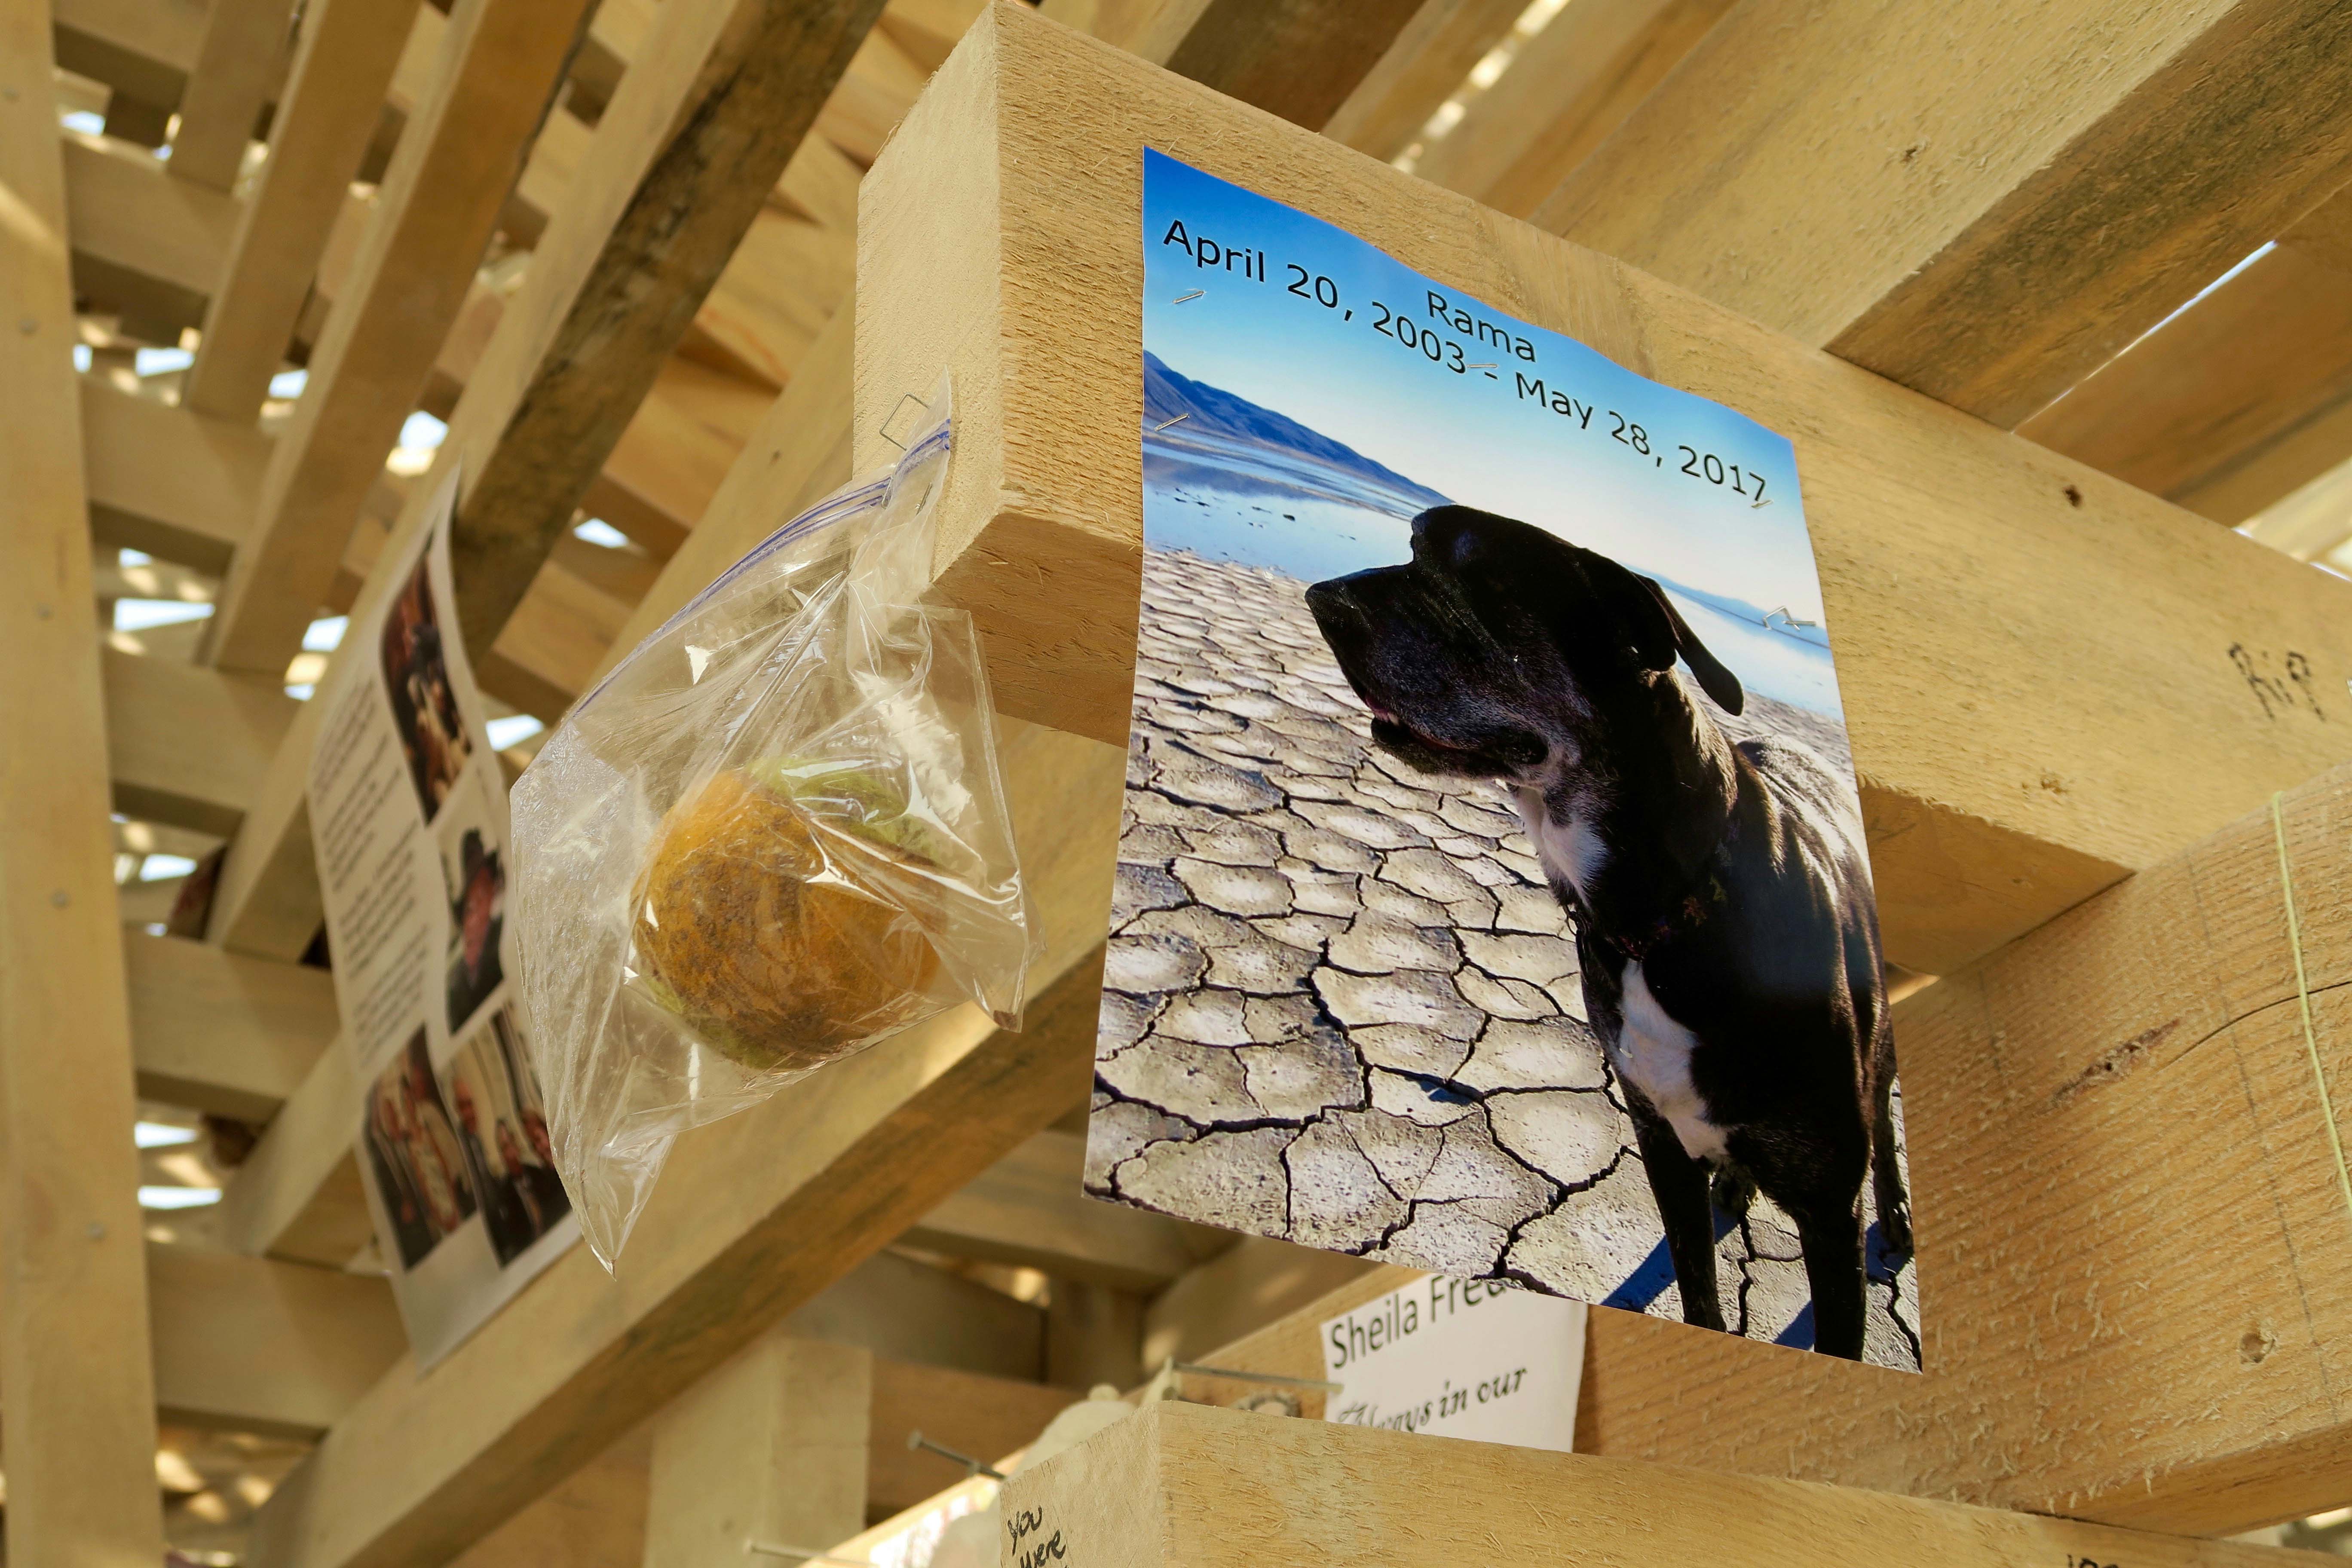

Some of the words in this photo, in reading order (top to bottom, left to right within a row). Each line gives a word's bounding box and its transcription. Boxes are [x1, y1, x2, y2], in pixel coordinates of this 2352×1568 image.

[1163, 219, 1265, 282] April
[1287, 263, 1353, 322] 20,
[1372, 301, 1466, 374] 2003
[1516, 371, 1593, 430] May
[1609, 410, 1663, 468] 28,
[1678, 444, 1766, 502] 2017
[1427, 290, 1536, 362] Rama
[1330, 1293, 1418, 1369] Sheila
[1439, 1379, 1468, 1418] in
[1476, 1368, 1527, 1404] our
